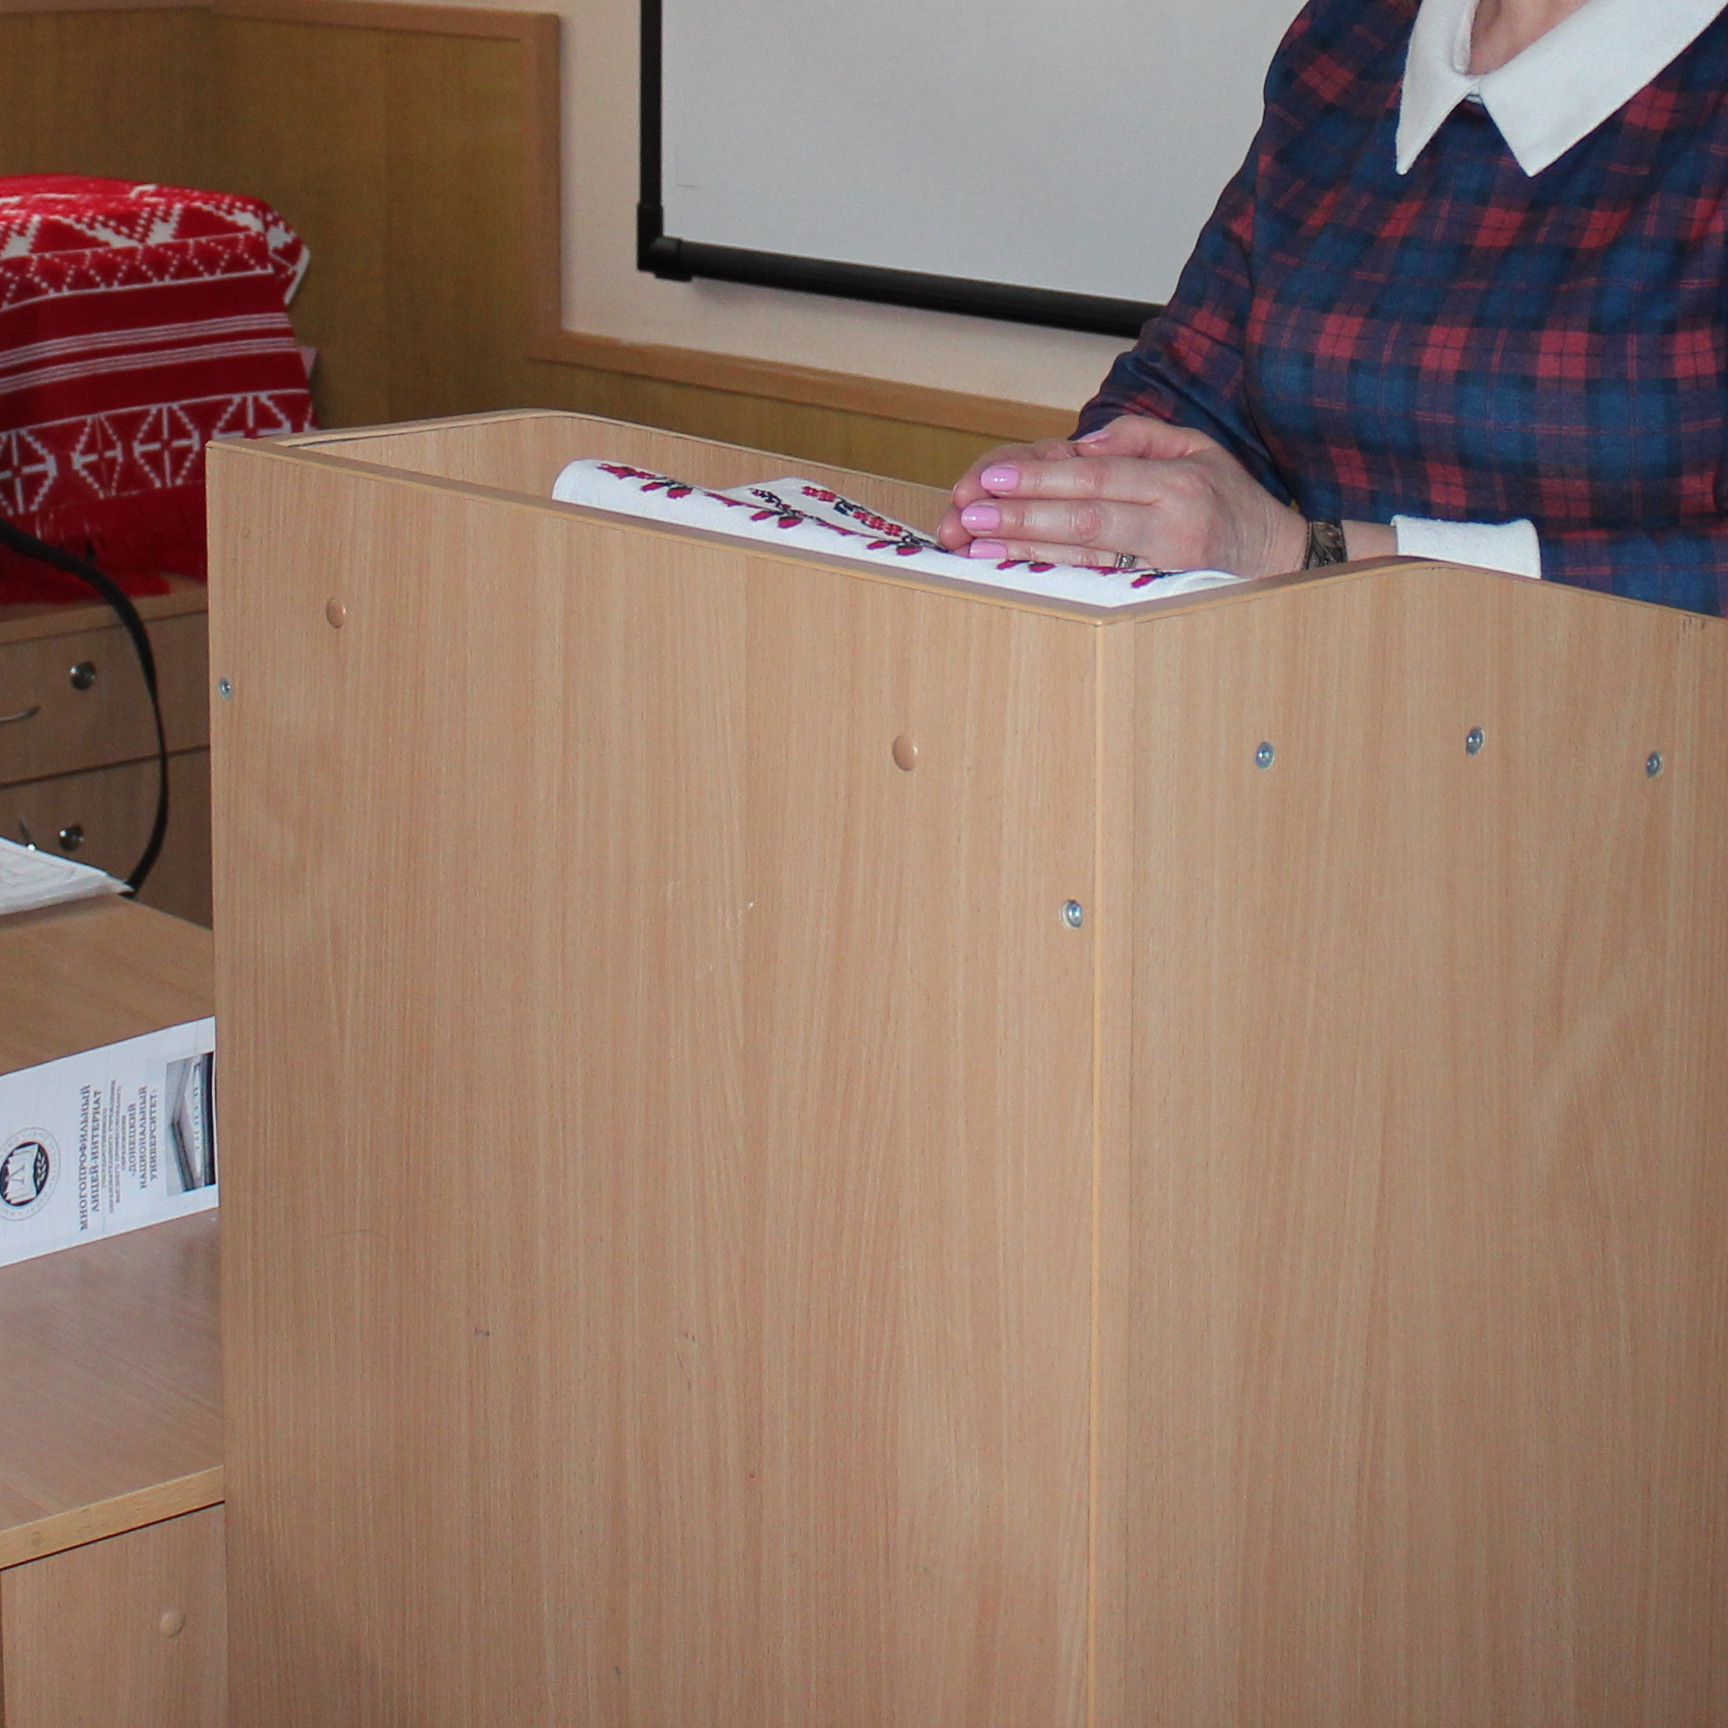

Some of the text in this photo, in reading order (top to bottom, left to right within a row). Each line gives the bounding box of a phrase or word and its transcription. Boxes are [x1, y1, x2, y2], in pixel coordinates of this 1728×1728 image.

[78, 1084, 92, 1232] МНОГОПРОФИЛЬНЫЙ
[90, 1089, 103, 1213] ЛИЦЕЙ-ИНТЕРНАТ
[138, 1086, 148, 1189] НАЦИОНАЛЬНЫЙ
